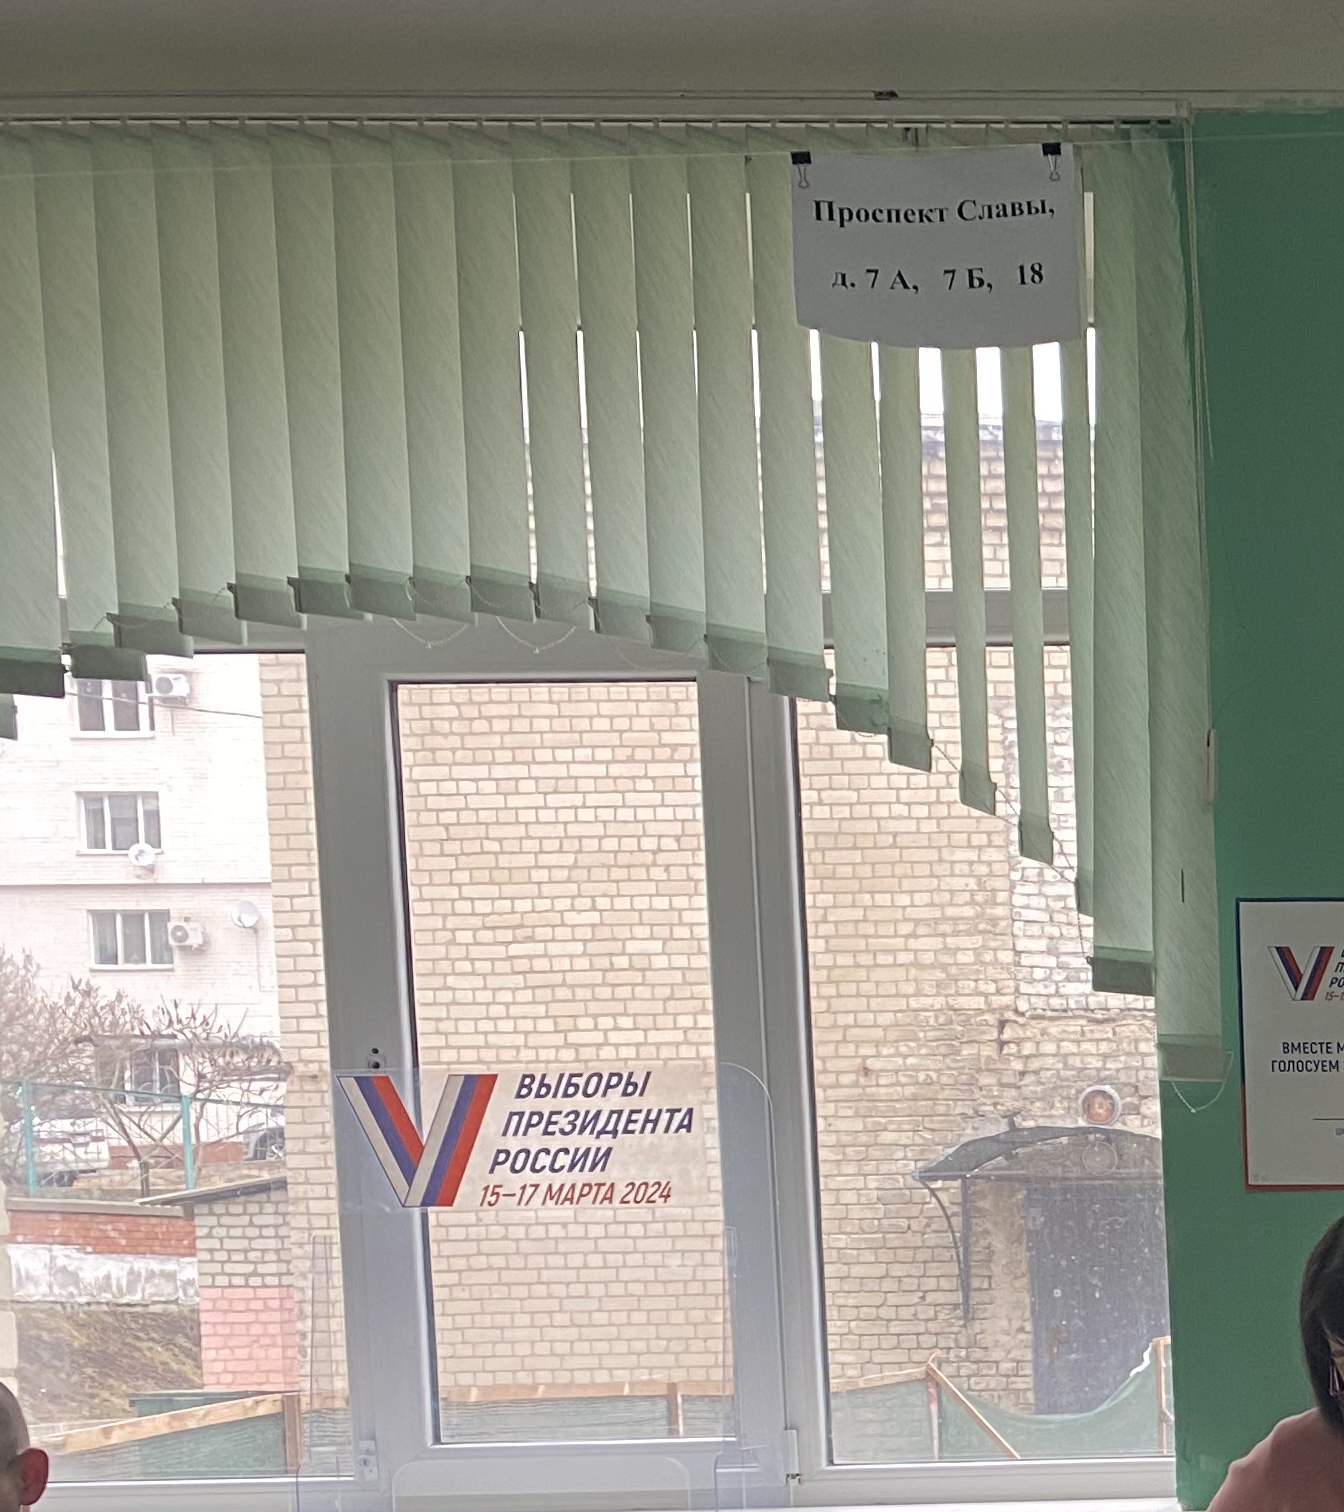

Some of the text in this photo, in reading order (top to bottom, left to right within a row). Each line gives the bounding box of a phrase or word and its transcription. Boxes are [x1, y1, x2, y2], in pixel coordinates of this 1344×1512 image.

[813, 198, 1055, 228] Проспект Славы,
[831, 262, 1044, 293] д. 7 А, 7 Б, 18
[1282, 1041, 1333, 1055] ВМЕСТЕ
[1271, 1060, 1339, 1073] ГОЛОСУЕМ
[515, 1070, 652, 1100] ВЫБОРЫ
[501, 1107, 694, 1139] ПРЕЗИДЕНТА
[489, 1146, 613, 1174] РОССИИ
[542, 1182, 615, 1206] МАРТА
[619, 1181, 671, 1205] 2024
